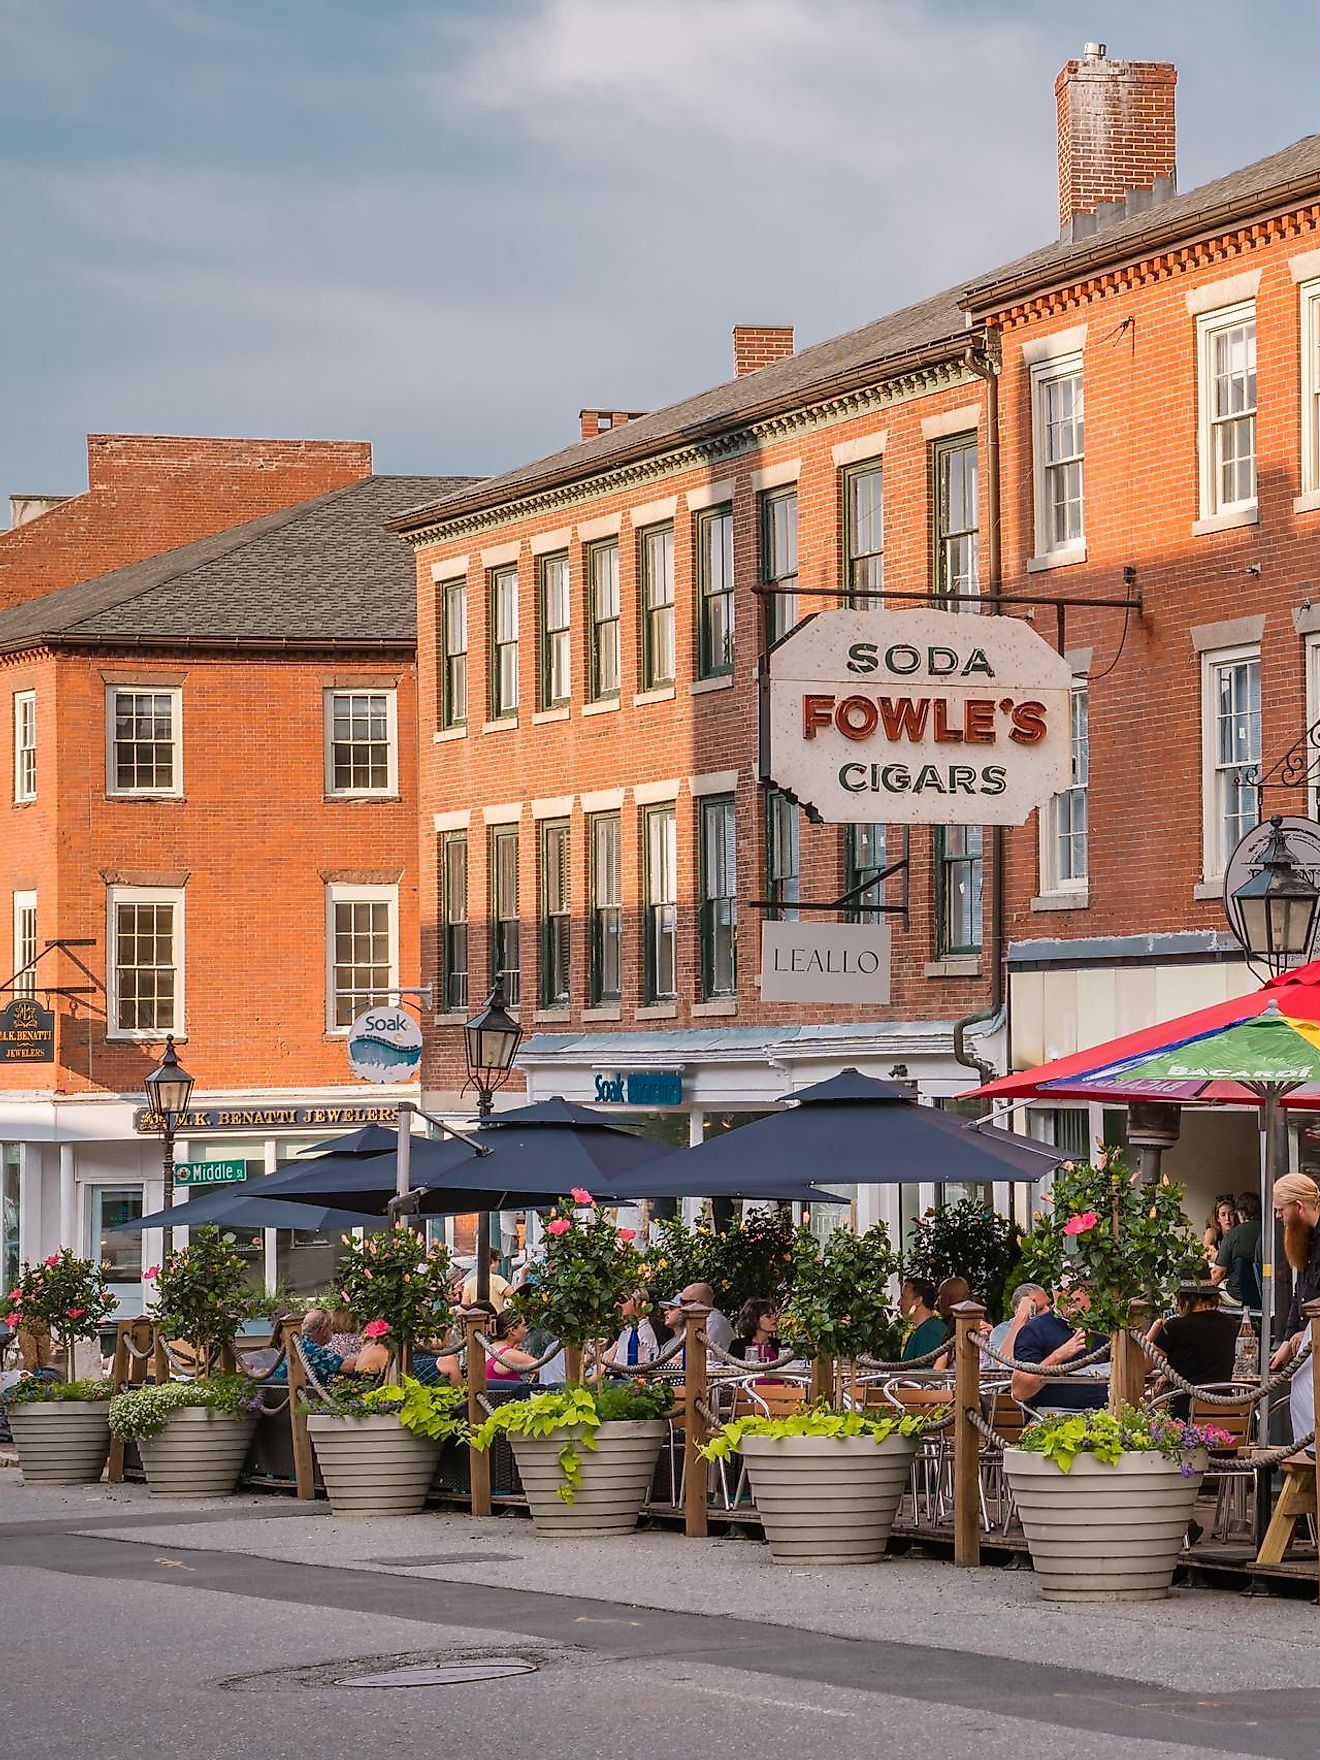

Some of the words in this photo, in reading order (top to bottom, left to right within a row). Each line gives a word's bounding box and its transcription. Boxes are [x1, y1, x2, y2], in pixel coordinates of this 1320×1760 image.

[847, 642, 996, 677] SODA
[802, 694, 1048, 746] FOWLE'S
[839, 762, 1007, 795] CIGARS
[774, 948, 879, 974] LEALLO
[365, 1014, 407, 1032] Soak
[17, 1030, 52, 1041] BENATTI
[5, 1048, 46, 1058] JEWELERS
[594, 1072, 625, 1102] Soak
[218, 1110, 298, 1125] BENATTI
[303, 1107, 400, 1124] JEWELERS
[192, 1163, 234, 1181] Middle
